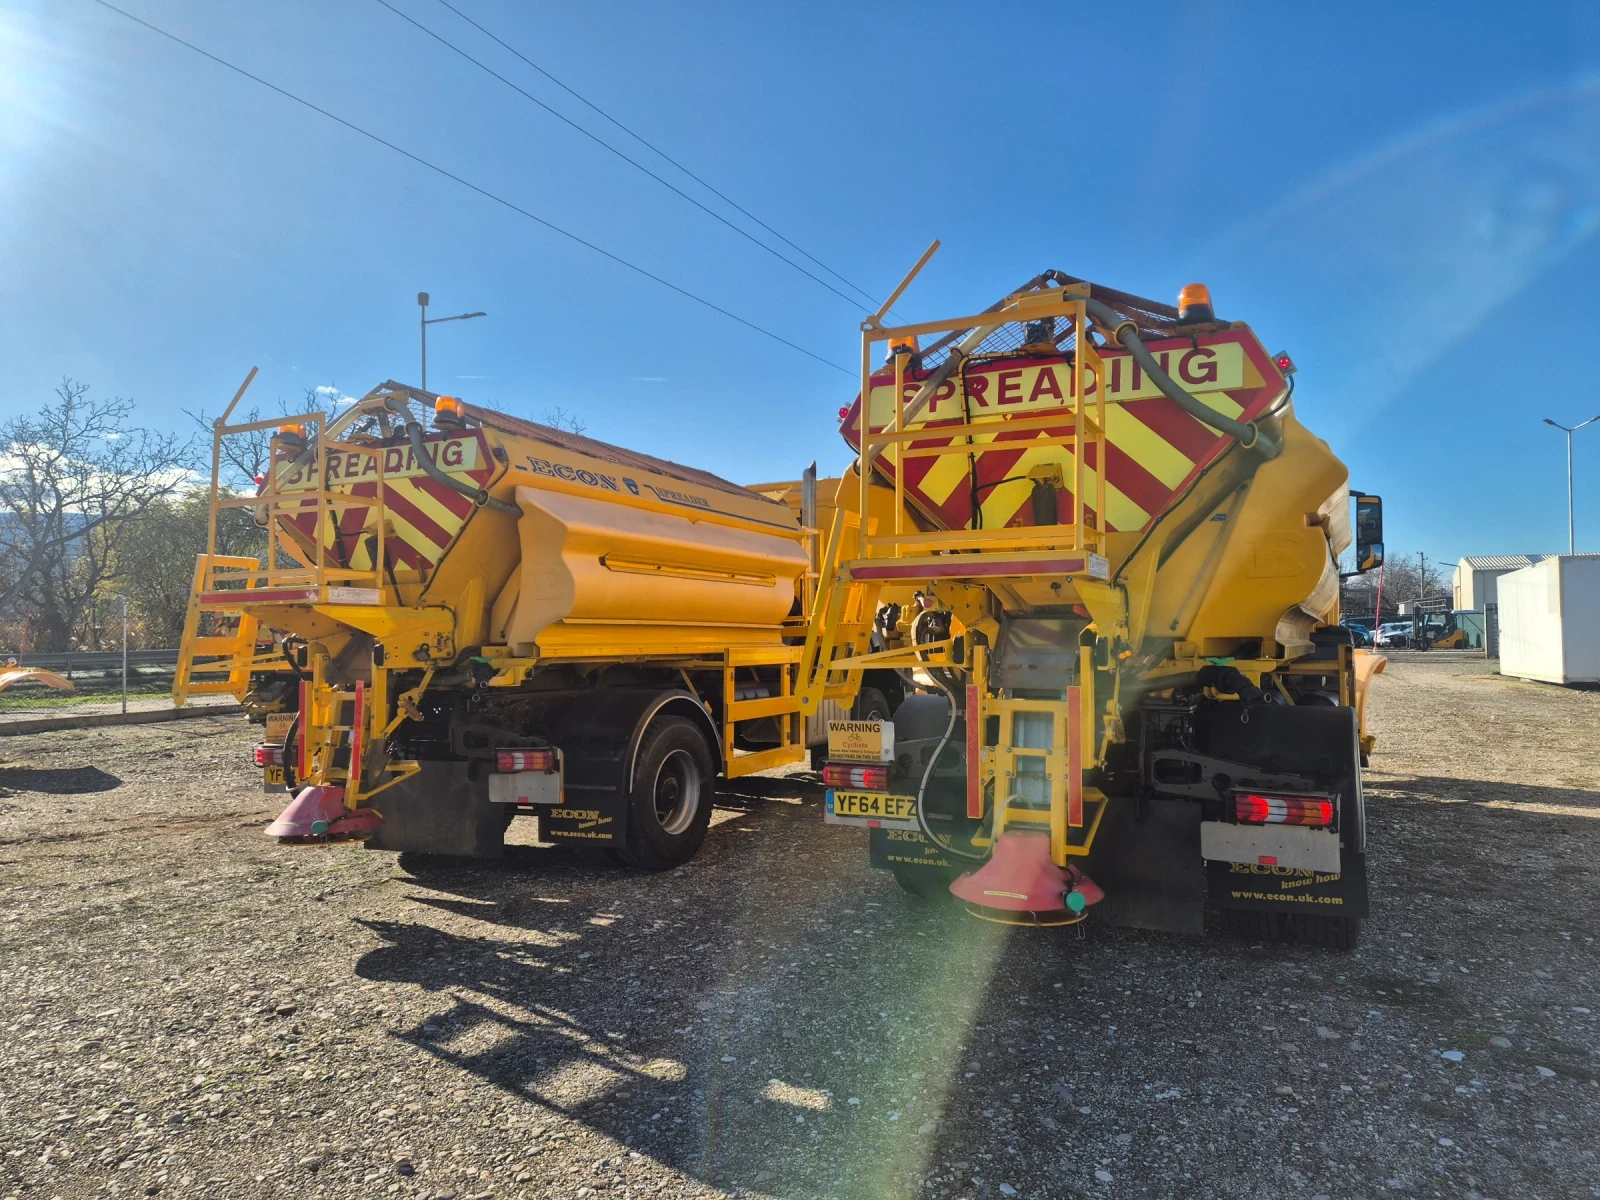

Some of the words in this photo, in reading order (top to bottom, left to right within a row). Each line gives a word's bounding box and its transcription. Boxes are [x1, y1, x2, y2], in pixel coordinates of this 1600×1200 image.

[526, 456, 620, 492] ECON
[656, 487, 711, 508] SPREADER
[829, 722, 881, 733] WARNING
[842, 741, 868, 749] Cyclists
[837, 795, 880, 814] YF64
[885, 797, 917, 816] EFZ
[550, 808, 600, 820] ECON
[578, 820, 597, 829] know
[598, 816, 613, 825] how
[550, 830, 613, 839] www.econ.uk.com
[1281, 878, 1313, 889] know
[1315, 873, 1341, 884] how
[1231, 890, 1343, 905] www.econ.uk.com
